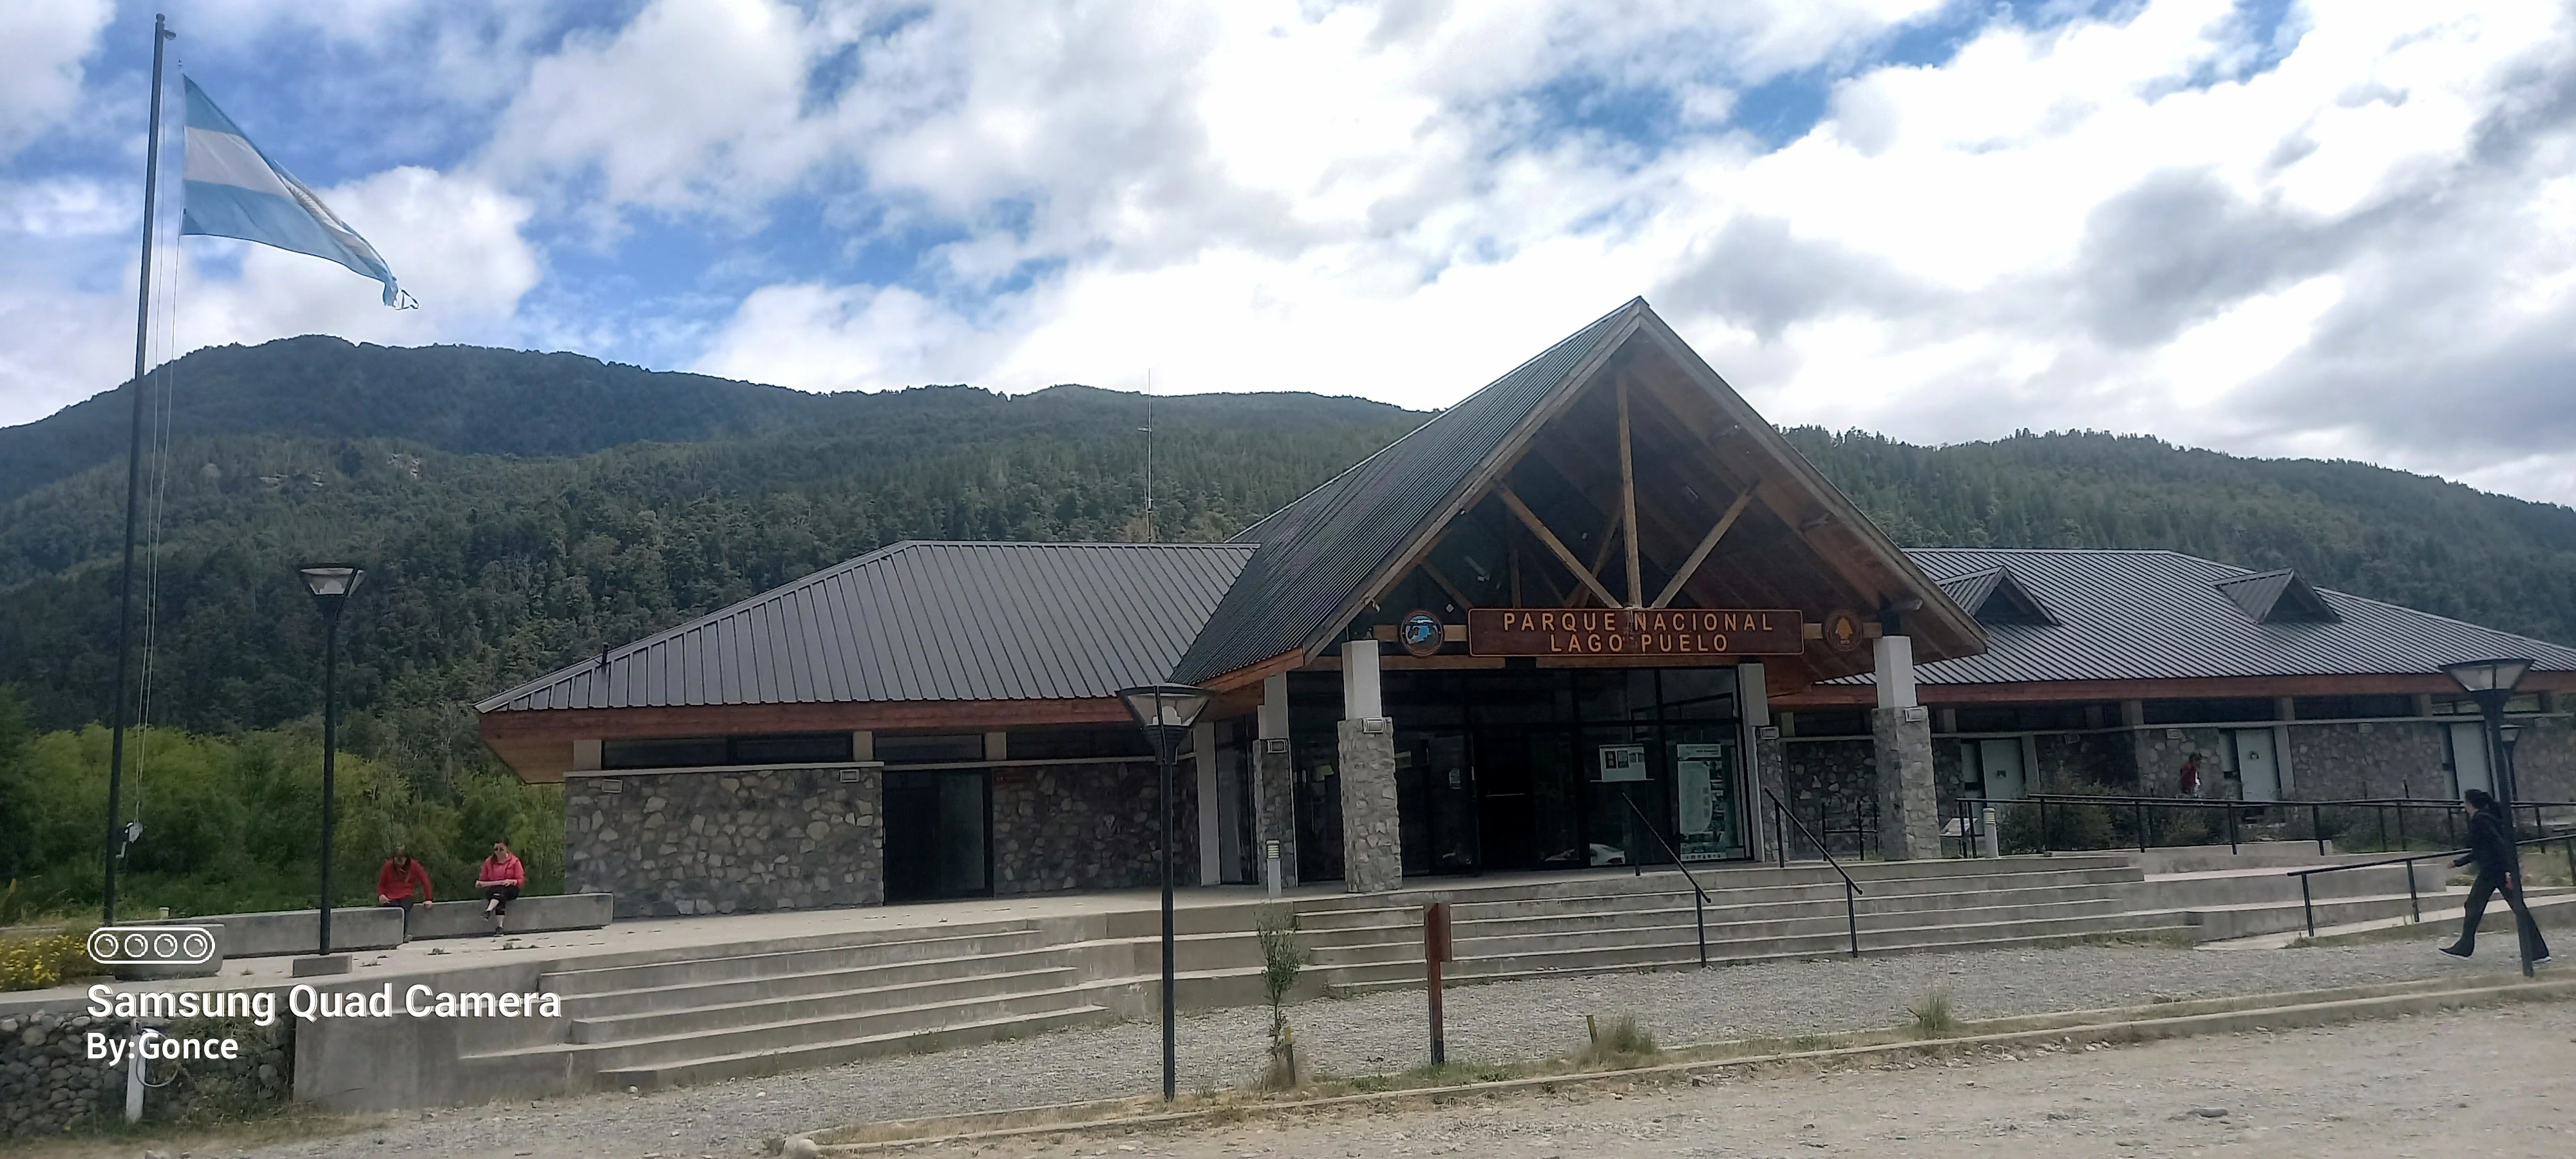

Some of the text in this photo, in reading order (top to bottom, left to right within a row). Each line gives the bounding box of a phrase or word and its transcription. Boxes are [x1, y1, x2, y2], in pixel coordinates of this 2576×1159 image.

[1504, 612, 1773, 632] PARQUE NACIONAL
[1550, 634, 1727, 652] LAGO PUELO
